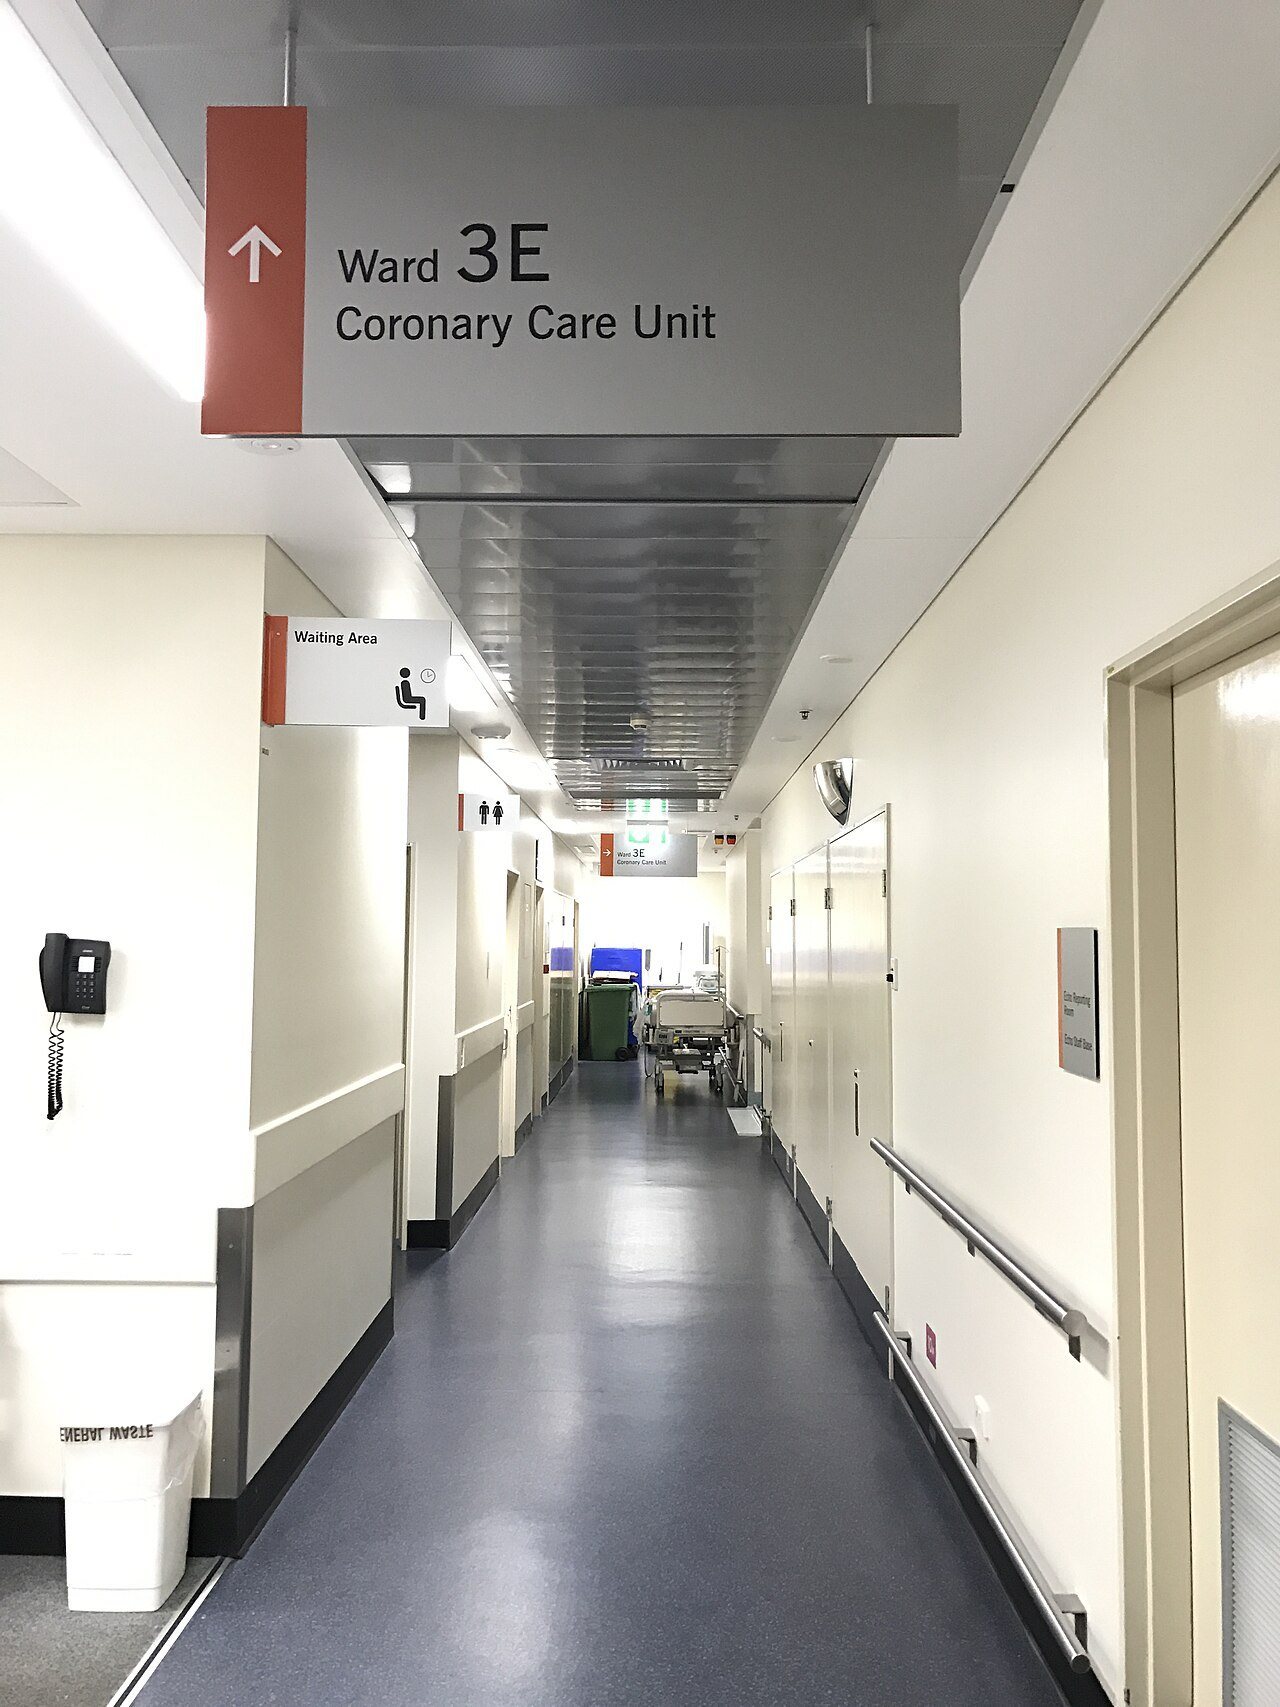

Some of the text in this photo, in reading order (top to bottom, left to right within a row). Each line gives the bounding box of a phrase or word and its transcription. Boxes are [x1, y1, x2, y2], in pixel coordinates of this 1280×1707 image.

[338, 223, 551, 284] Ward 3E
[336, 302, 717, 347] Coronary Care Unit
[294, 630, 378, 646] Waiting Area
[632, 848, 645, 858] 3E
